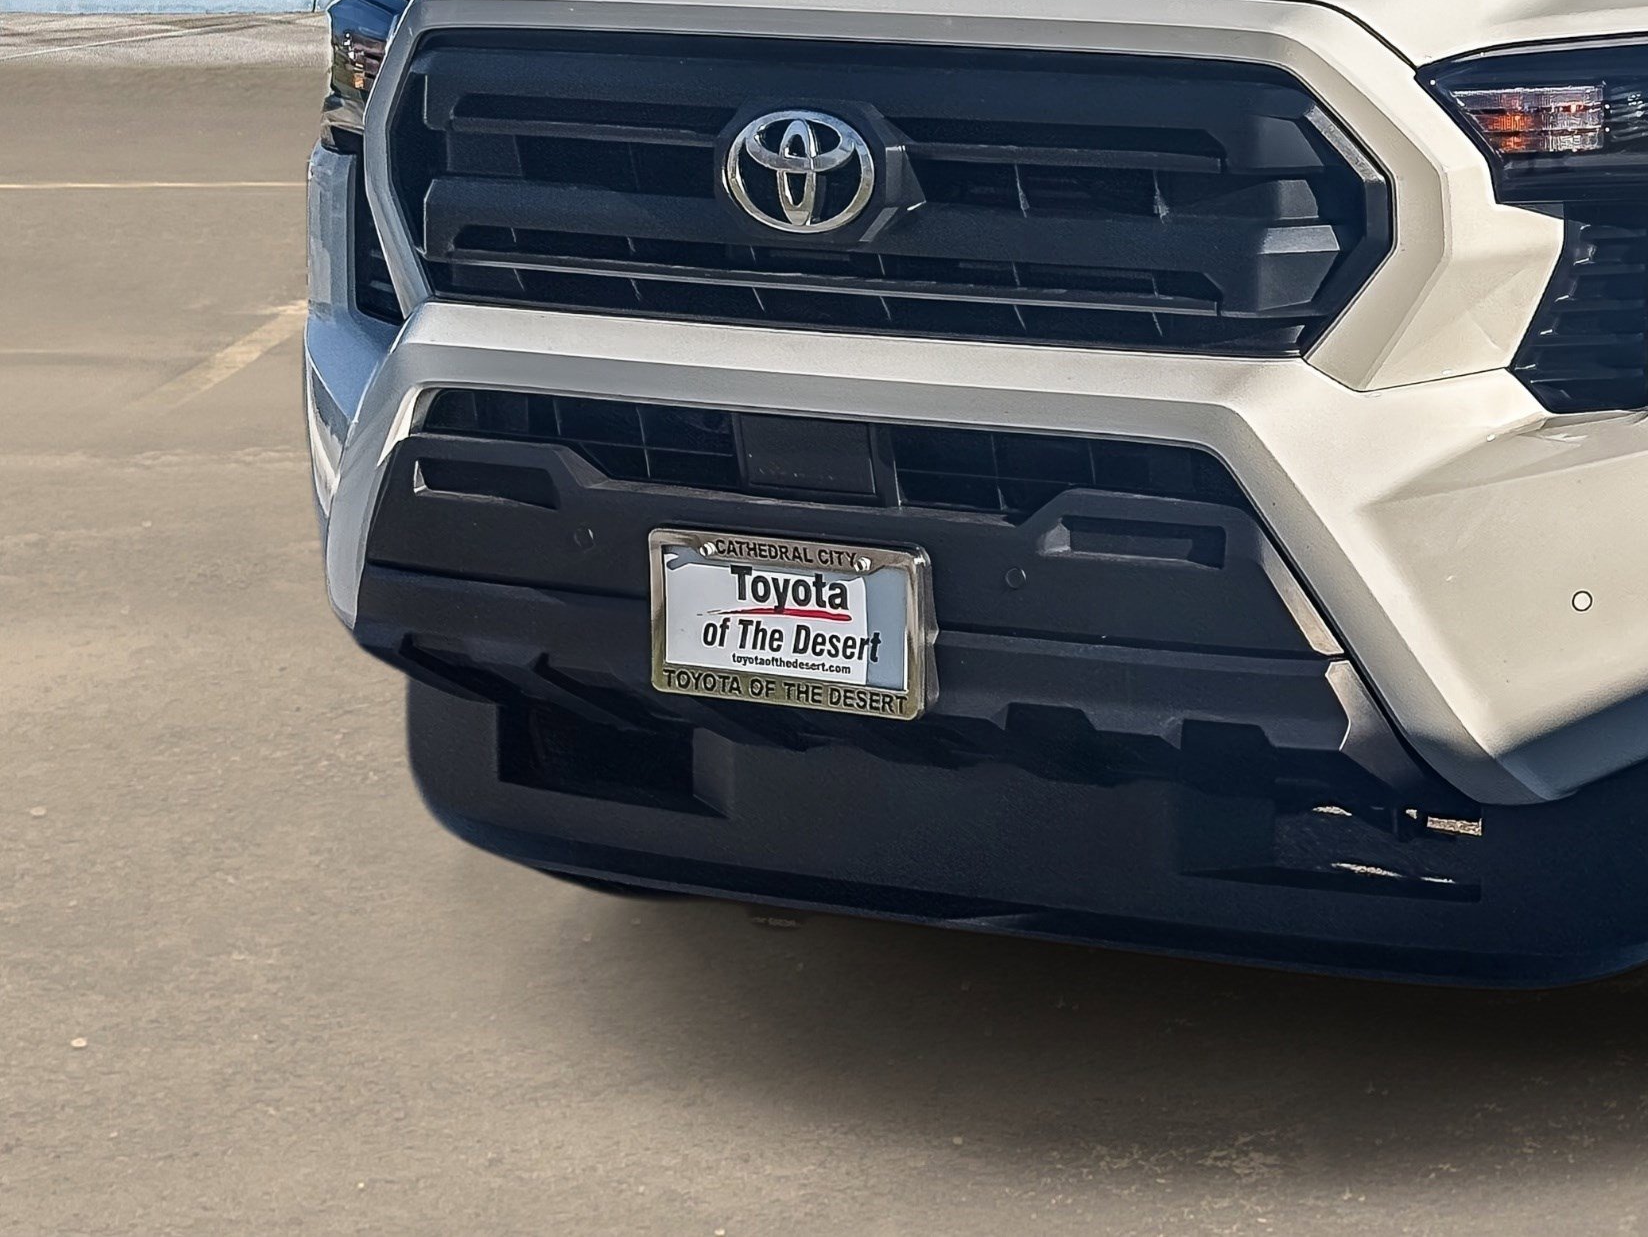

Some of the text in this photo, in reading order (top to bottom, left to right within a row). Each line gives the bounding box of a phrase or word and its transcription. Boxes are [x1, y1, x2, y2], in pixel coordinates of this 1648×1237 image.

[715, 539, 857, 567] CATHEDRAL CITY
[730, 564, 849, 612] Toyota
[703, 617, 881, 662] of The Desert
[732, 652, 851, 674] toyotaofthedesert.com
[663, 669, 908, 714] TOYOTA OF THE DESERT
